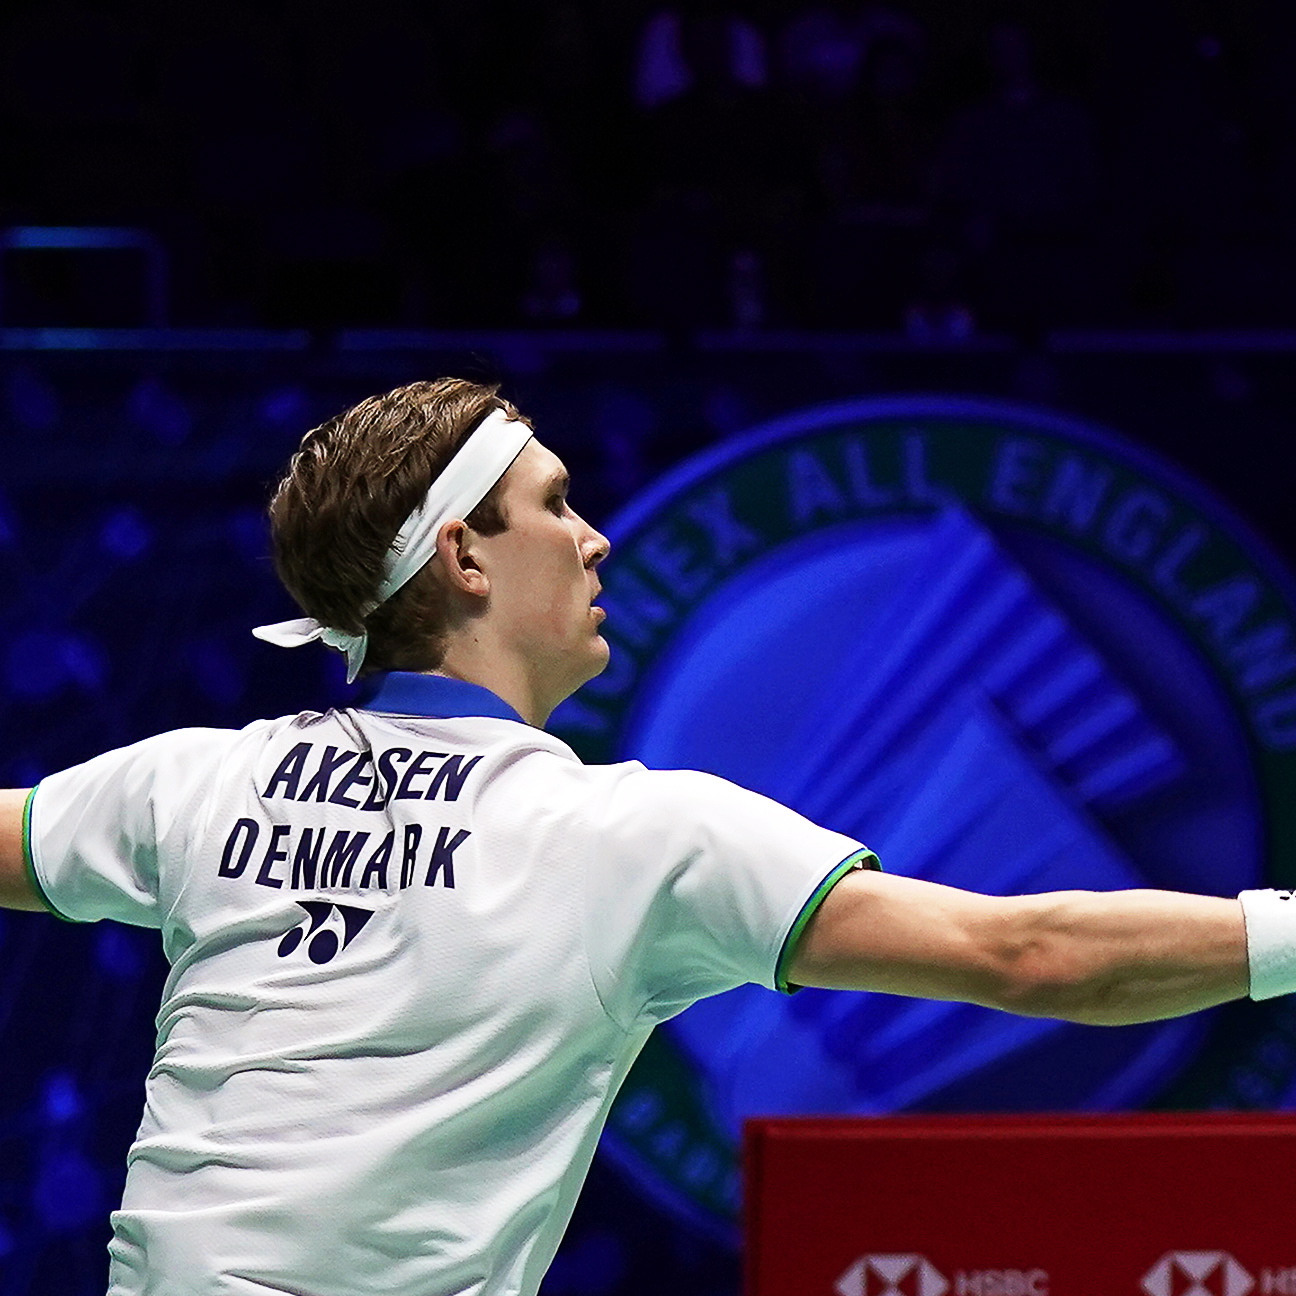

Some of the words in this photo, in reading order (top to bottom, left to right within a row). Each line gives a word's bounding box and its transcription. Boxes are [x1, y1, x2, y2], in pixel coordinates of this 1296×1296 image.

[786, 428, 949, 496] ALL
[261, 742, 484, 811] AXELSEN
[218, 817, 471, 889] DENMARK
